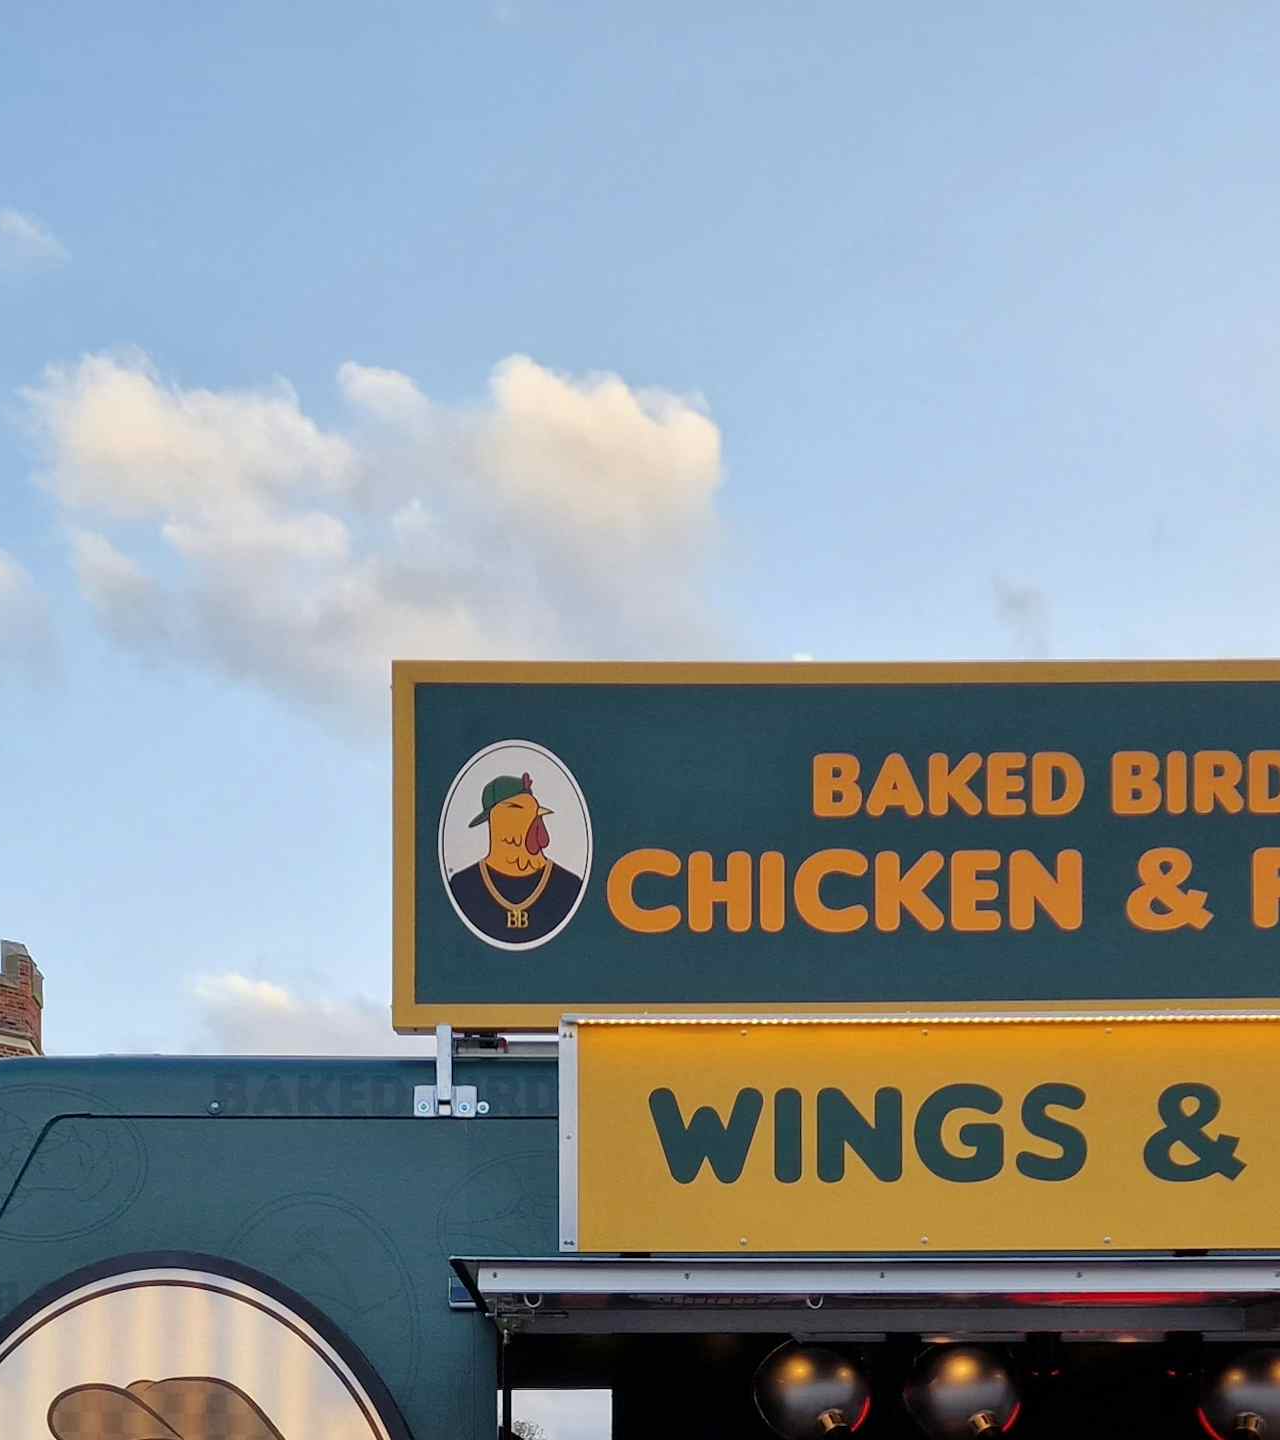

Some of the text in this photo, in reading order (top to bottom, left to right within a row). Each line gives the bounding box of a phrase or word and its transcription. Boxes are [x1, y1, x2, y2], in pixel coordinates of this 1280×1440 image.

[811, 751, 1086, 819] BAKED
[605, 849, 1086, 935] CHICKEN
[1123, 847, 1212, 934] &
[649, 1085, 1086, 1182] WINGS
[1143, 1086, 1245, 1181] &
